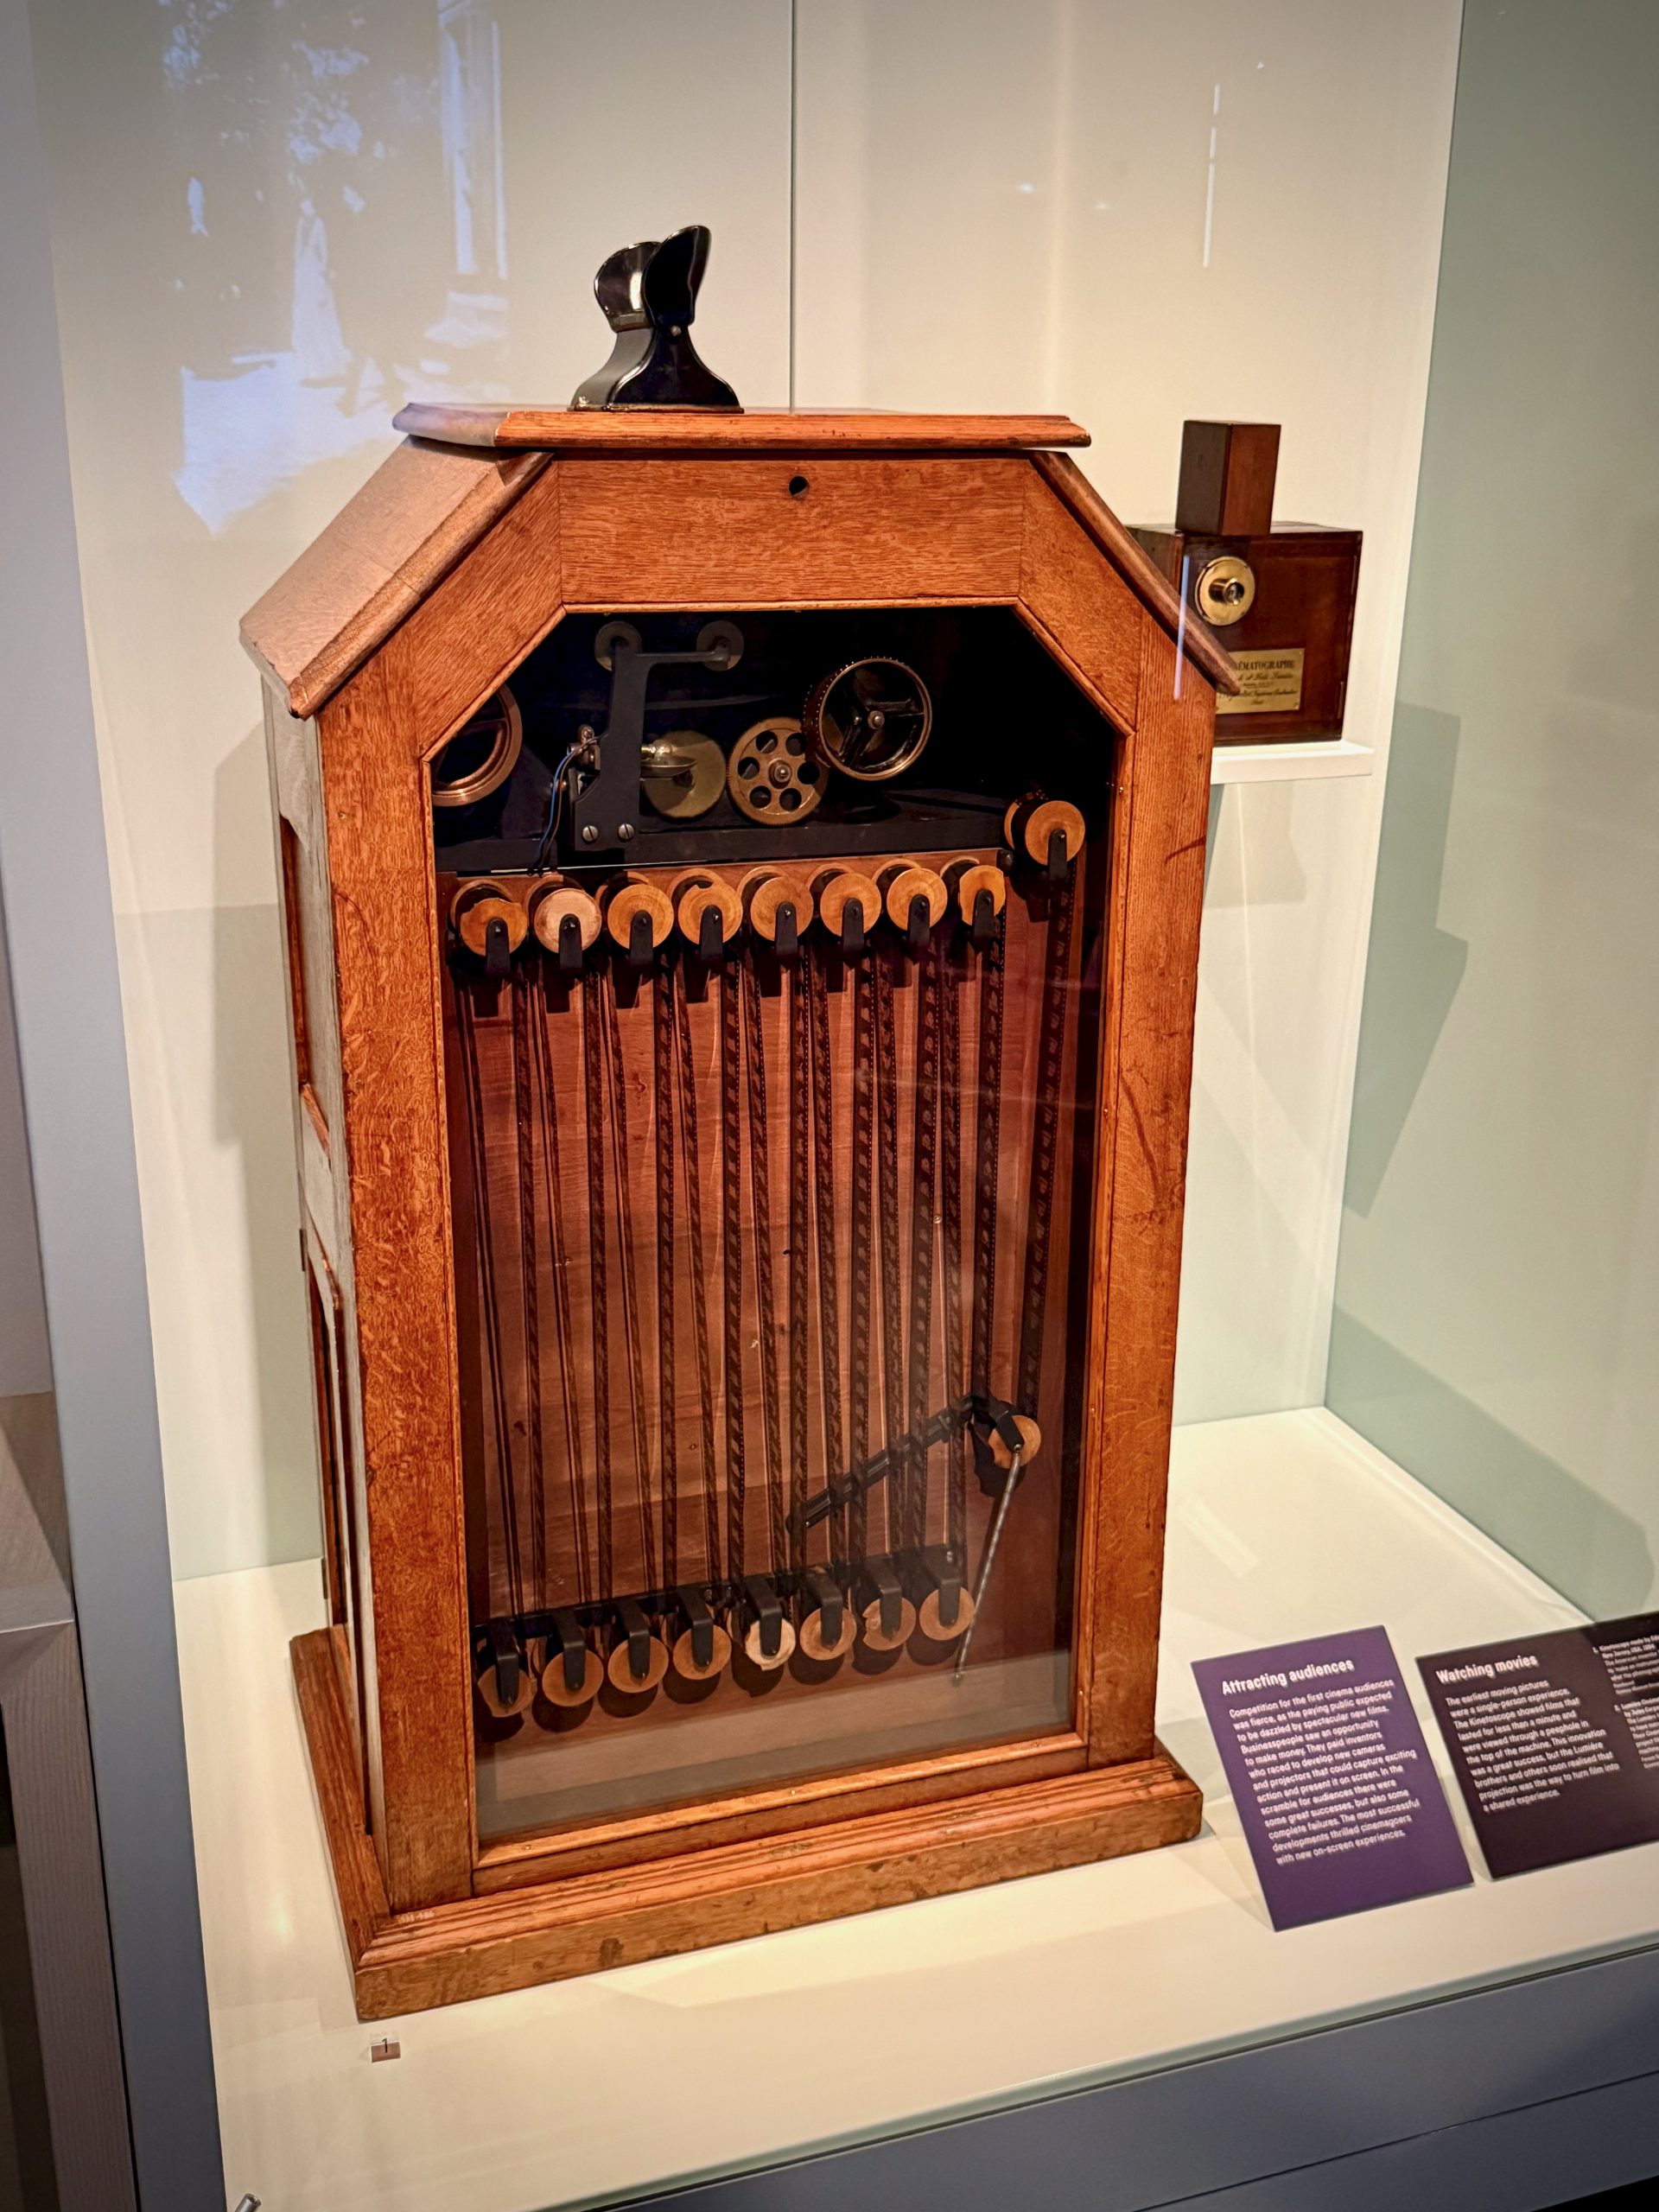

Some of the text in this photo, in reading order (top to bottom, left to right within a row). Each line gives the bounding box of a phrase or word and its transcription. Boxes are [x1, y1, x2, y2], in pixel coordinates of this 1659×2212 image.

[1223, 1661, 1353, 1694] Attracting audiences
[1436, 1656, 1537, 1682] Watching movies
[1230, 1703, 1278, 1718] Competition
[1306, 1693, 1324, 1702] first
[1325, 1688, 1353, 1699] cinema
[1354, 1680, 1394, 1693] audiences
[1446, 1681, 1548, 1706] The earliest moving pictures
[1450, 1709, 1469, 1718] were
[1476, 1697, 1527, 1713] single-person
[1233, 1721, 1249, 1730] was
[1302, 1705, 1329, 1717] paying
[1330, 1700, 1354, 1712] public
[1356, 1691, 1392, 1705] expected
[1458, 1729, 1483, 1740] lasted
[1495, 1725, 1511, 1733] less
[1535, 1714, 1561, 1725] minute
[1562, 1710, 1577, 1719] and
[1469, 1712, 1516, 1726] Kinetoscope
[1516, 1704, 1545, 1716] showed
[1545, 1701, 1564, 1710] films
[1564, 1697, 1580, 1706] that
[1241, 1735, 1303, 1753] Businesspeople
[1321, 1729, 1332, 1738] an
[1332, 1720, 1378, 1735] opportunity
[1247, 1732, 1259, 1740] be
[1260, 1724, 1291, 1737] dazzled
[1291, 1723, 1302, 1732] by
[1303, 1713, 1348, 1729] spectacular
[1462, 1744, 1481, 1752] were
[1482, 1737, 1509, 1748] viewed
[1509, 1731, 1539, 1742] through
[1546, 1722, 1580, 1736] peephole
[1255, 1754, 1277, 1764] make
[1306, 1744, 1325, 1752] They
[1326, 1738, 1344, 1751] paid
[1345, 1732, 1382, 1745] inventors
[1495, 1749, 1503, 1758] of
[1567, 1730, 1605, 1742] innovation
[1249, 1769, 1266, 1778] who
[1267, 1762, 1291, 1774] raced
[1301, 1755, 1333, 1767] develop
[1352, 1744, 1385, 1756] cameras
[1253, 1750, 1416, 1790] and projectors that could capture exciting
[1474, 1751, 1613, 1788] brothers and others soon realised that
[1493, 1761, 1512, 1773] great
[1545, 1751, 1559, 1759] but
[1257, 1791, 1282, 1802] action
[1284, 1786, 1300, 1796] and
[1300, 1780, 1331, 1795] present
[1261, 1780, 1396, 1815] scramble for audiences there were
[1479, 1786, 1518, 1801] projection
[1572, 1770, 1589, 1778] turn
[1588, 1766, 1604, 1775] film
[1265, 1816, 1287, 1827] some
[1287, 1811, 1309, 1824] great
[1354, 1797, 1369, 1808] but
[1370, 1795, 1386, 1804] also
[1388, 1789, 1409, 1800] some
[1268, 1825, 1306, 1839] complete
[1357, 1809, 1376, 1820] most
[1378, 1799, 1420, 1815] successful
[1490, 1797, 1516, 1810] shared
[1273, 1815, 1411, 1852] developments thrilled cinemagoers
[1276, 1853, 1294, 1865] with
[1295, 1851, 1312, 1859] new
[1313, 1841, 1354, 1856] on-screen
[381, 2037, 388, 2053] 1
